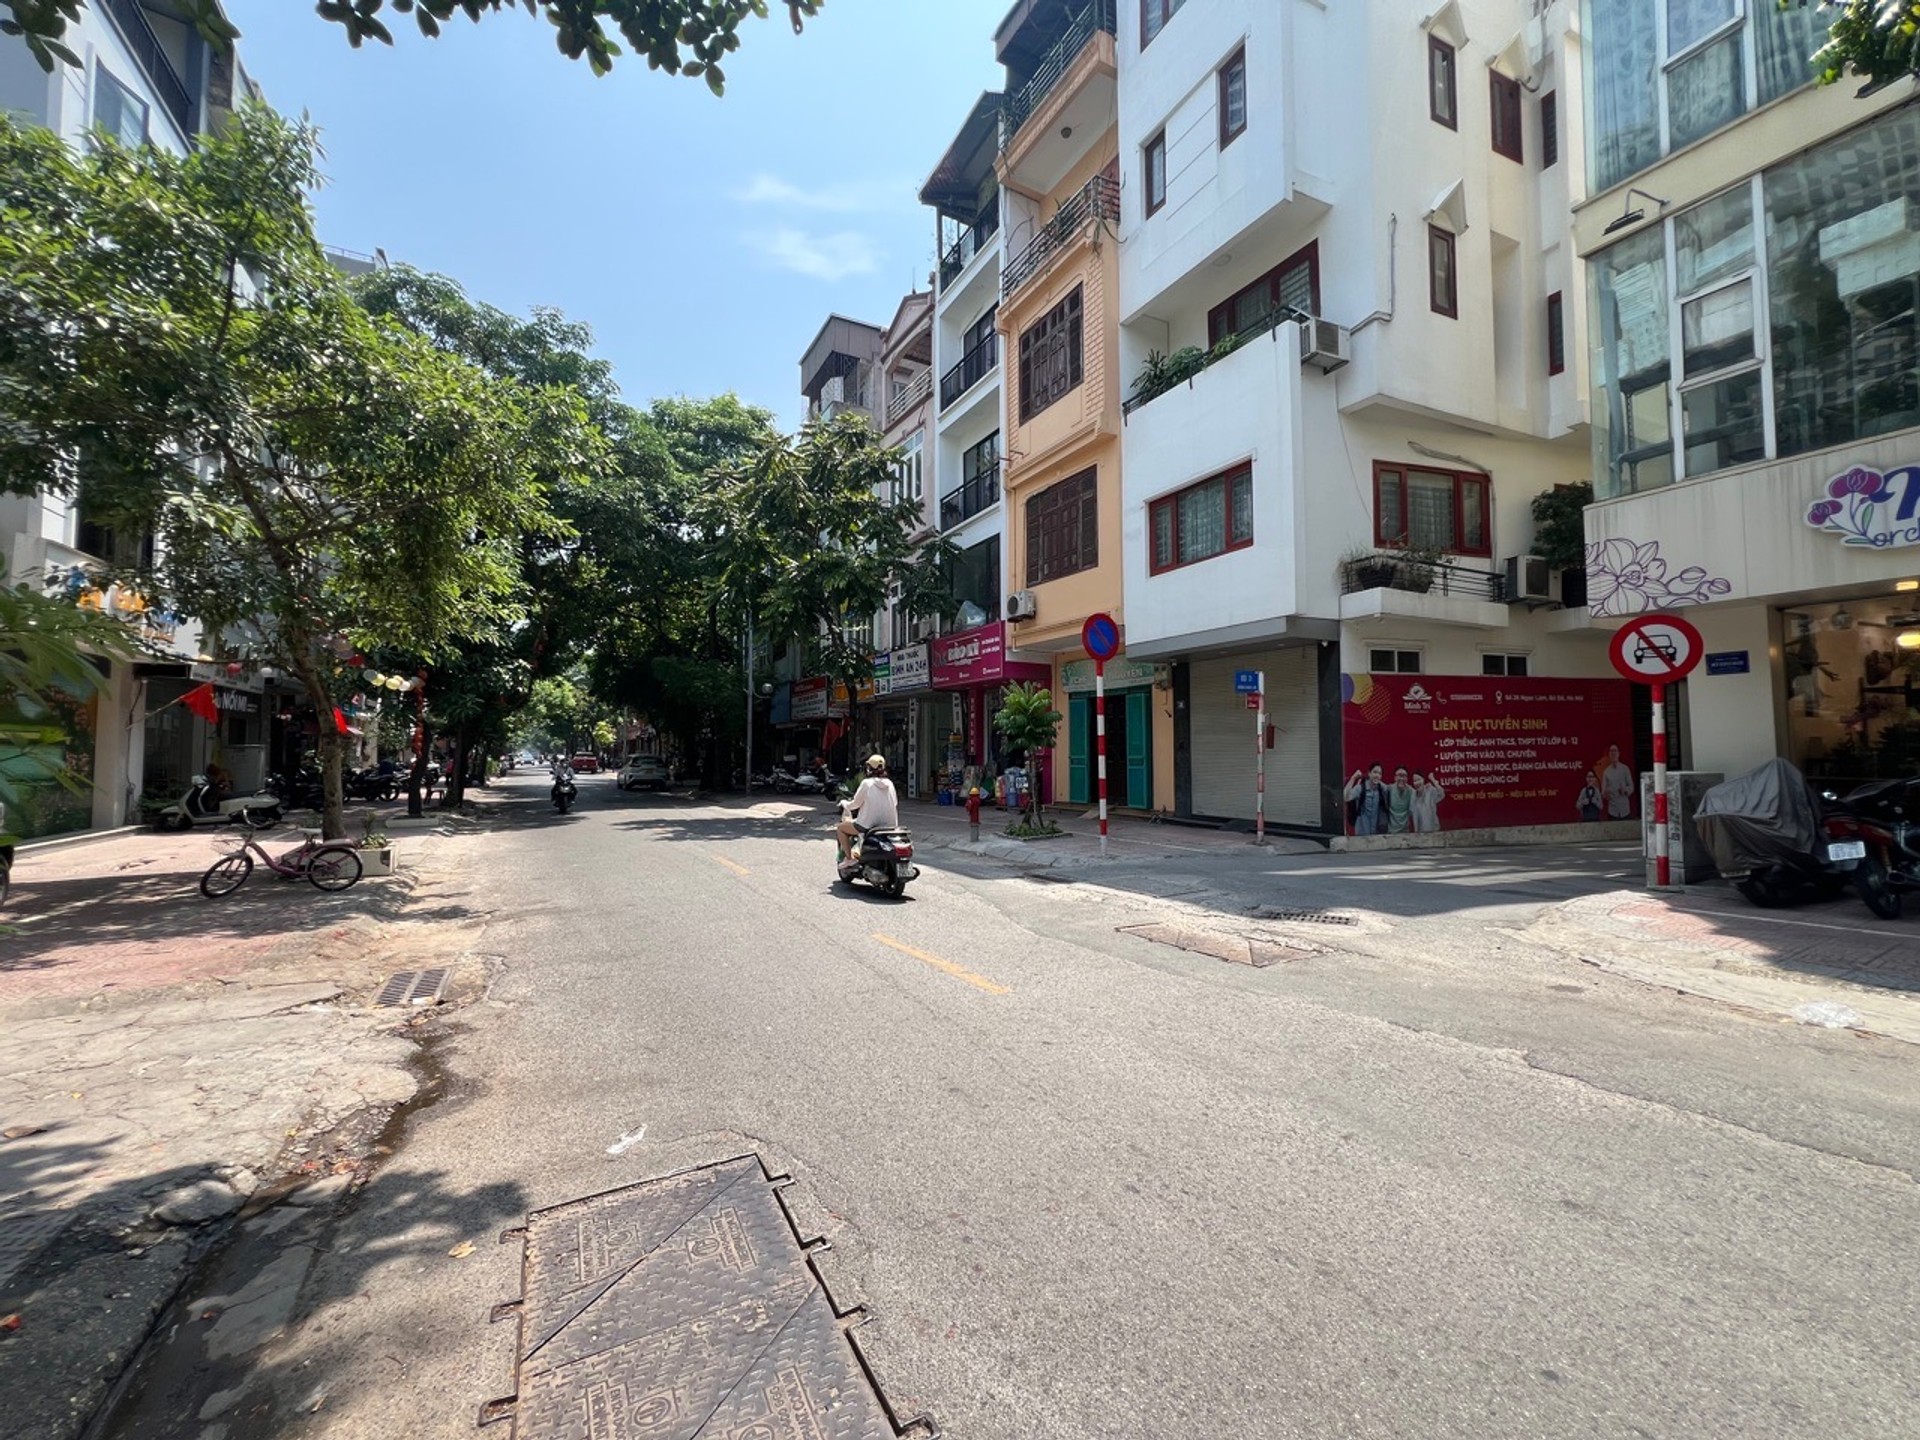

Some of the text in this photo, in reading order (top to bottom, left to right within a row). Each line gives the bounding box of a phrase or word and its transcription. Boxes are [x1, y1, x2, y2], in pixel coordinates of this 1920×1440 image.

[1432, 714, 1548, 734] LIÊN TỤC TUYỂN SINH
[1439, 737, 1455, 747] LỚP
[1456, 735, 1478, 747] TIẾNG
[1479, 738, 1495, 747] ANH
[1440, 750, 1465, 761] LUYỆN
[1466, 751, 1479, 759] THI
[1479, 749, 1495, 759] VÀO
[1506, 748, 1537, 759] CHUYÊN
[1440, 762, 1465, 774] LUYỆN
[1466, 763, 1479, 772] THI
[1480, 763, 1493, 774] ĐẠI
[1512, 760, 1534, 770] ĐÁNH
[1534, 760, 1547, 770] GIÁ
[1547, 760, 1568, 769] NĂNG
[1569, 760, 1583, 771] LỰC
[1440, 775, 1465, 787] LUYỆN
[1466, 776, 1479, 784] THI
[1479, 774, 1506, 784] CHỨNG
